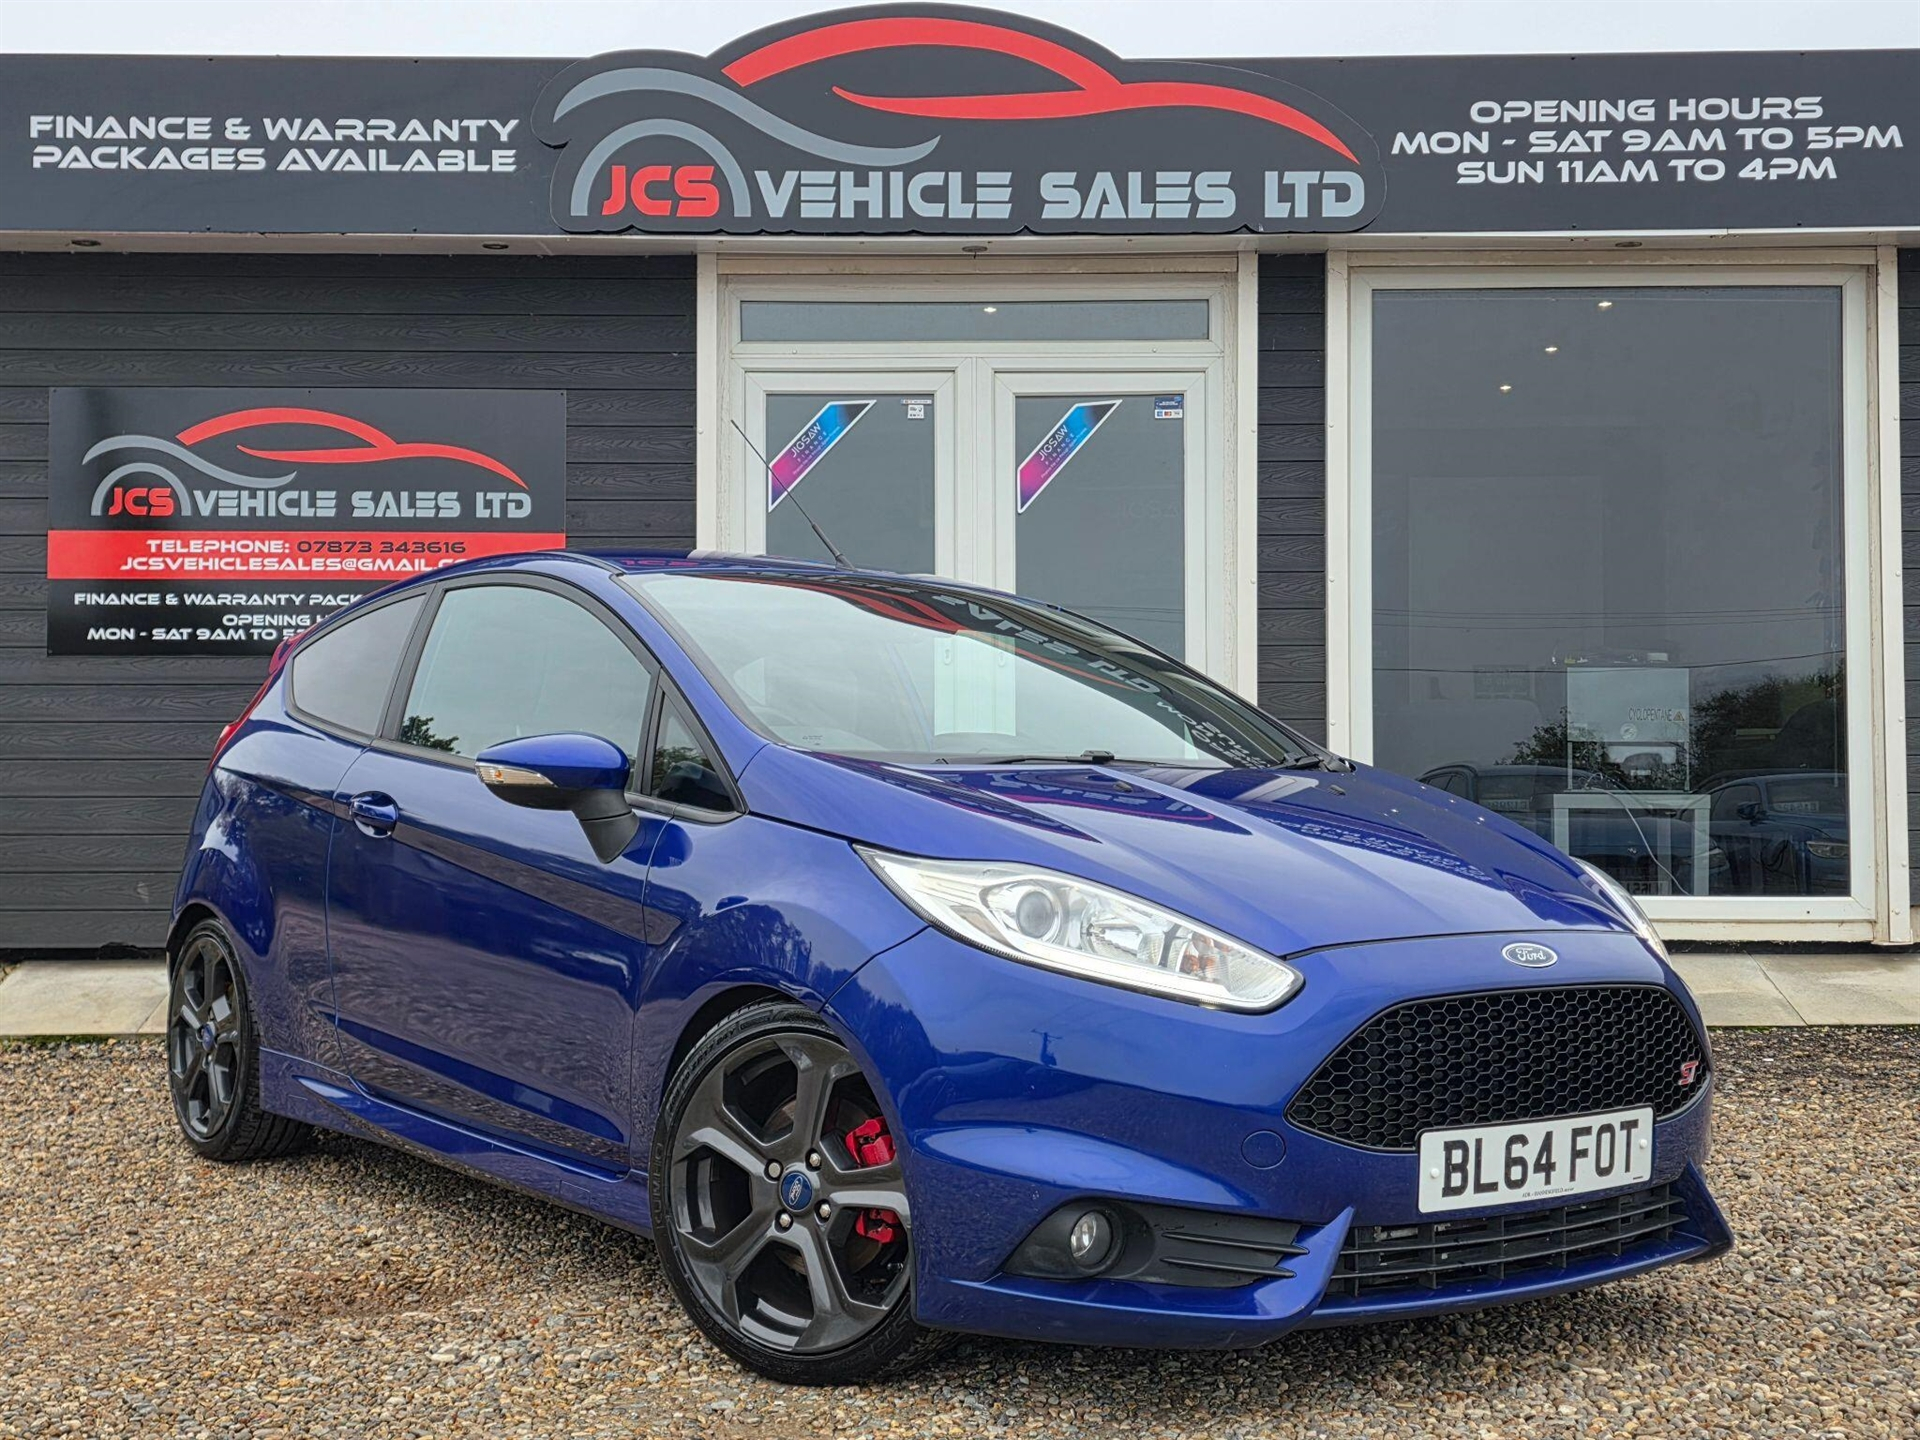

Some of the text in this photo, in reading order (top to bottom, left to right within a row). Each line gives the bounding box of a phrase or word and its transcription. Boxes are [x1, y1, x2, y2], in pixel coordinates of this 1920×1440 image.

[1469, 96, 1824, 124] OPENING HOURS
[29, 115, 520, 142] FINANCE & WARRANTY
[1391, 130, 1490, 155] MON
[1528, 129, 1614, 154] SAT
[1621, 128, 1727, 153] 9AM
[1735, 127, 1794, 151] TO
[1806, 124, 1904, 150] 5PM
[32, 145, 517, 172] PACKAGES AVAILABLE
[1456, 156, 1838, 184] SUN 11AM TO 4PM
[601, 165, 1366, 219] JCS VEHICLE SALES LTD
[791, 421, 822, 458] JIGSAW
[1039, 424, 1069, 462] JIGSAW
[108, 487, 533, 520] JCS VEHICLE SALES LTD
[146, 539, 466, 554] TELEPHONE: 07873 343616
[120, 557, 467, 572] JCSVEHICLESALES@GMAIL.C
[74, 593, 160, 606] FINANCE
[165, 593, 179, 606] &
[183, 593, 305, 606] WARRANTY
[222, 614, 311, 627] OPENING
[87, 628, 135, 640] MON
[151, 628, 193, 640] SAT
[196, 628, 246, 641] 9AM
[249, 628, 278, 641] TO
[1515, 947, 1548, 961] Ford
[1678, 1060, 1699, 1086] ST
[1441, 1118, 1640, 1198] BL64 FOT
